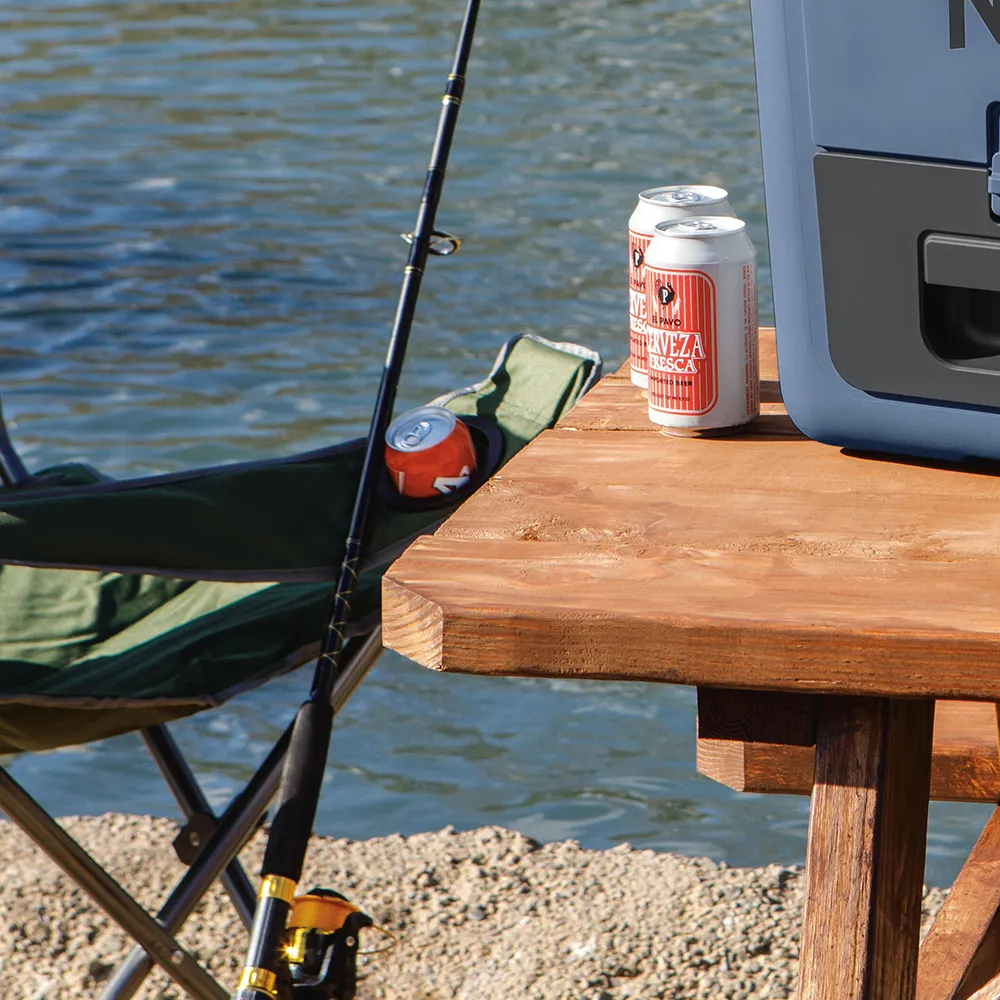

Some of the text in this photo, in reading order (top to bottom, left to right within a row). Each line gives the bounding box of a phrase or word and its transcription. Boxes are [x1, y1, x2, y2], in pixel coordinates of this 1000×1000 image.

[662, 289, 669, 303] P
[652, 315, 682, 327] EL PAVO
[647, 330, 706, 359] ERVEZA
[649, 353, 697, 374] FRESCA
